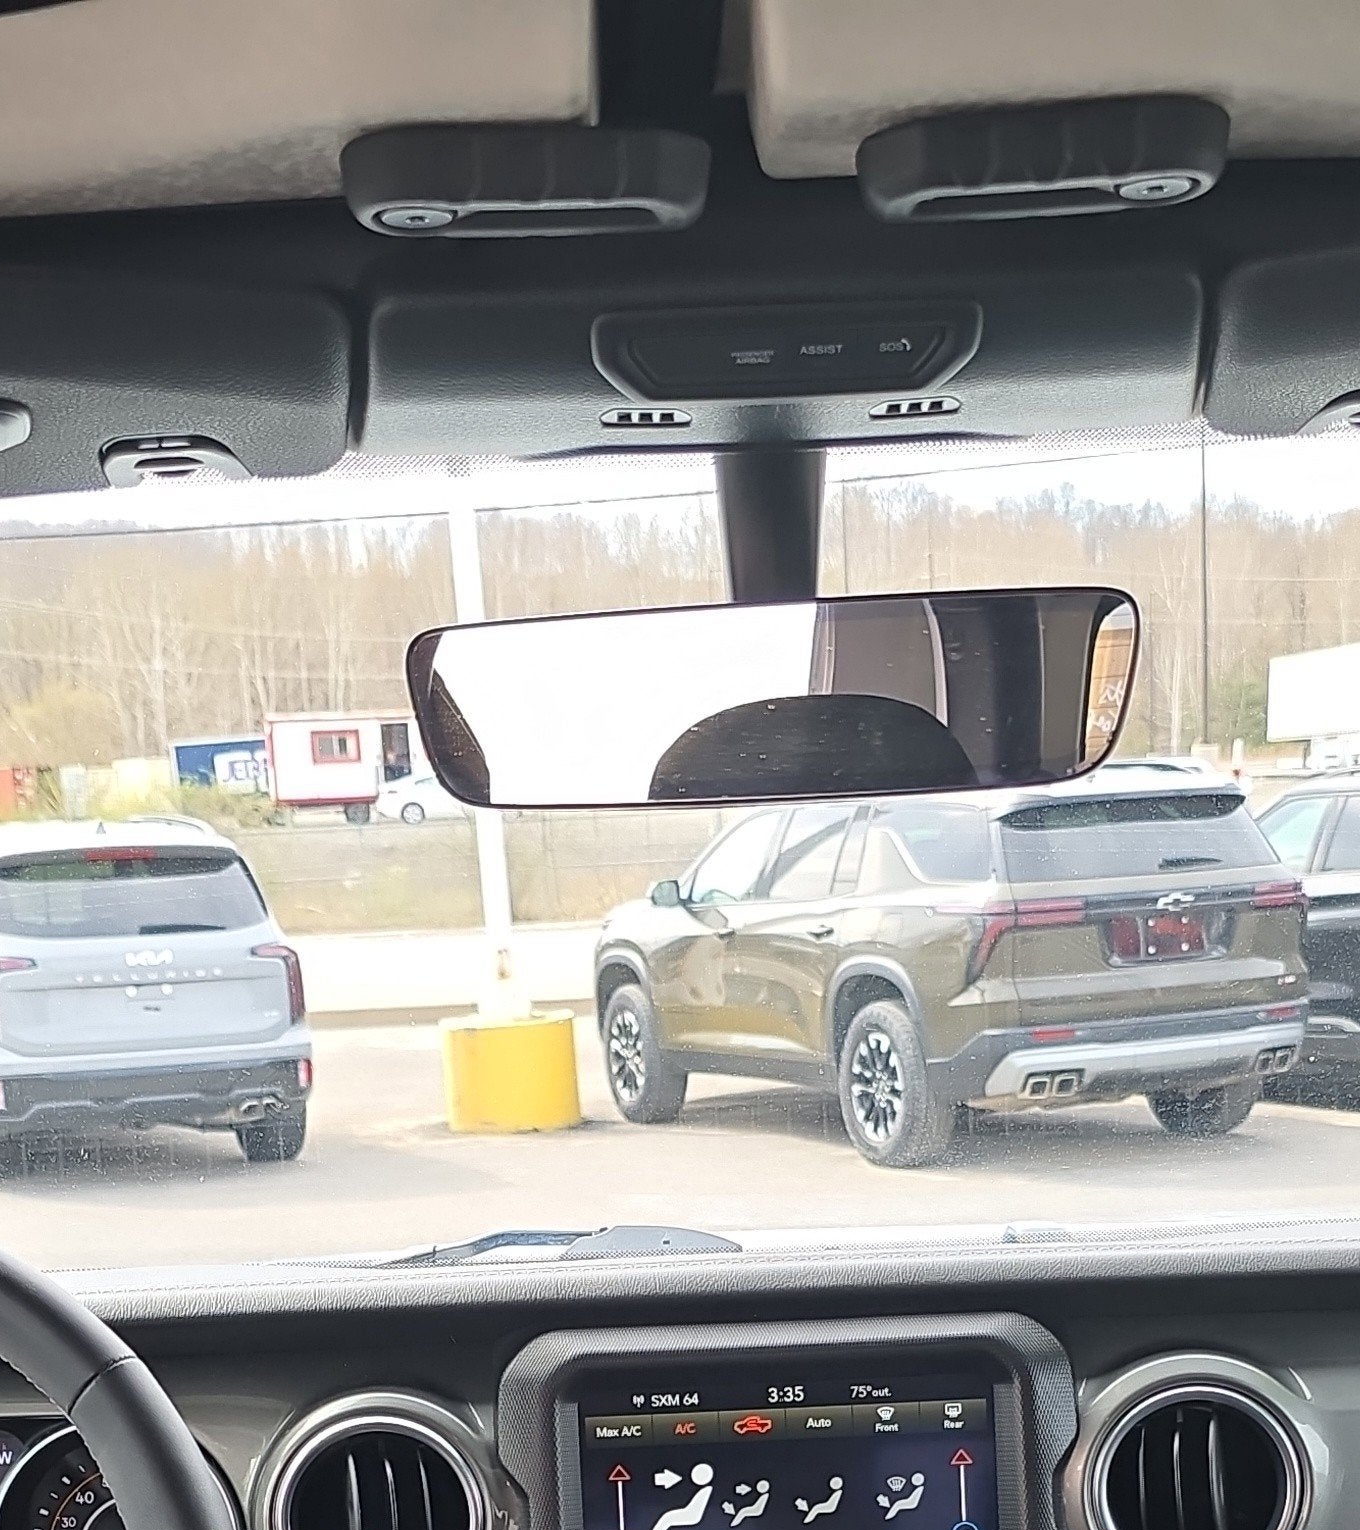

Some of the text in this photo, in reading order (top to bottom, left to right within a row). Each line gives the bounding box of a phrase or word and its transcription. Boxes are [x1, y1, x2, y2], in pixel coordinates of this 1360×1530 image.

[799, 344, 842, 355] ASSIST
[879, 343, 904, 352] SOS
[651, 1393, 699, 1407] SXM 64
[767, 1386, 804, 1403] 3:35
[805, 1418, 832, 1428] Auto
[875, 1423, 899, 1432] Front
[944, 1419, 964, 1429] Rear
[596, 1425, 642, 1438] Max A/C
[674, 1423, 696, 1435] A/C
[75, 1491, 95, 1504] 40
[61, 1517, 77, 1528] 30
